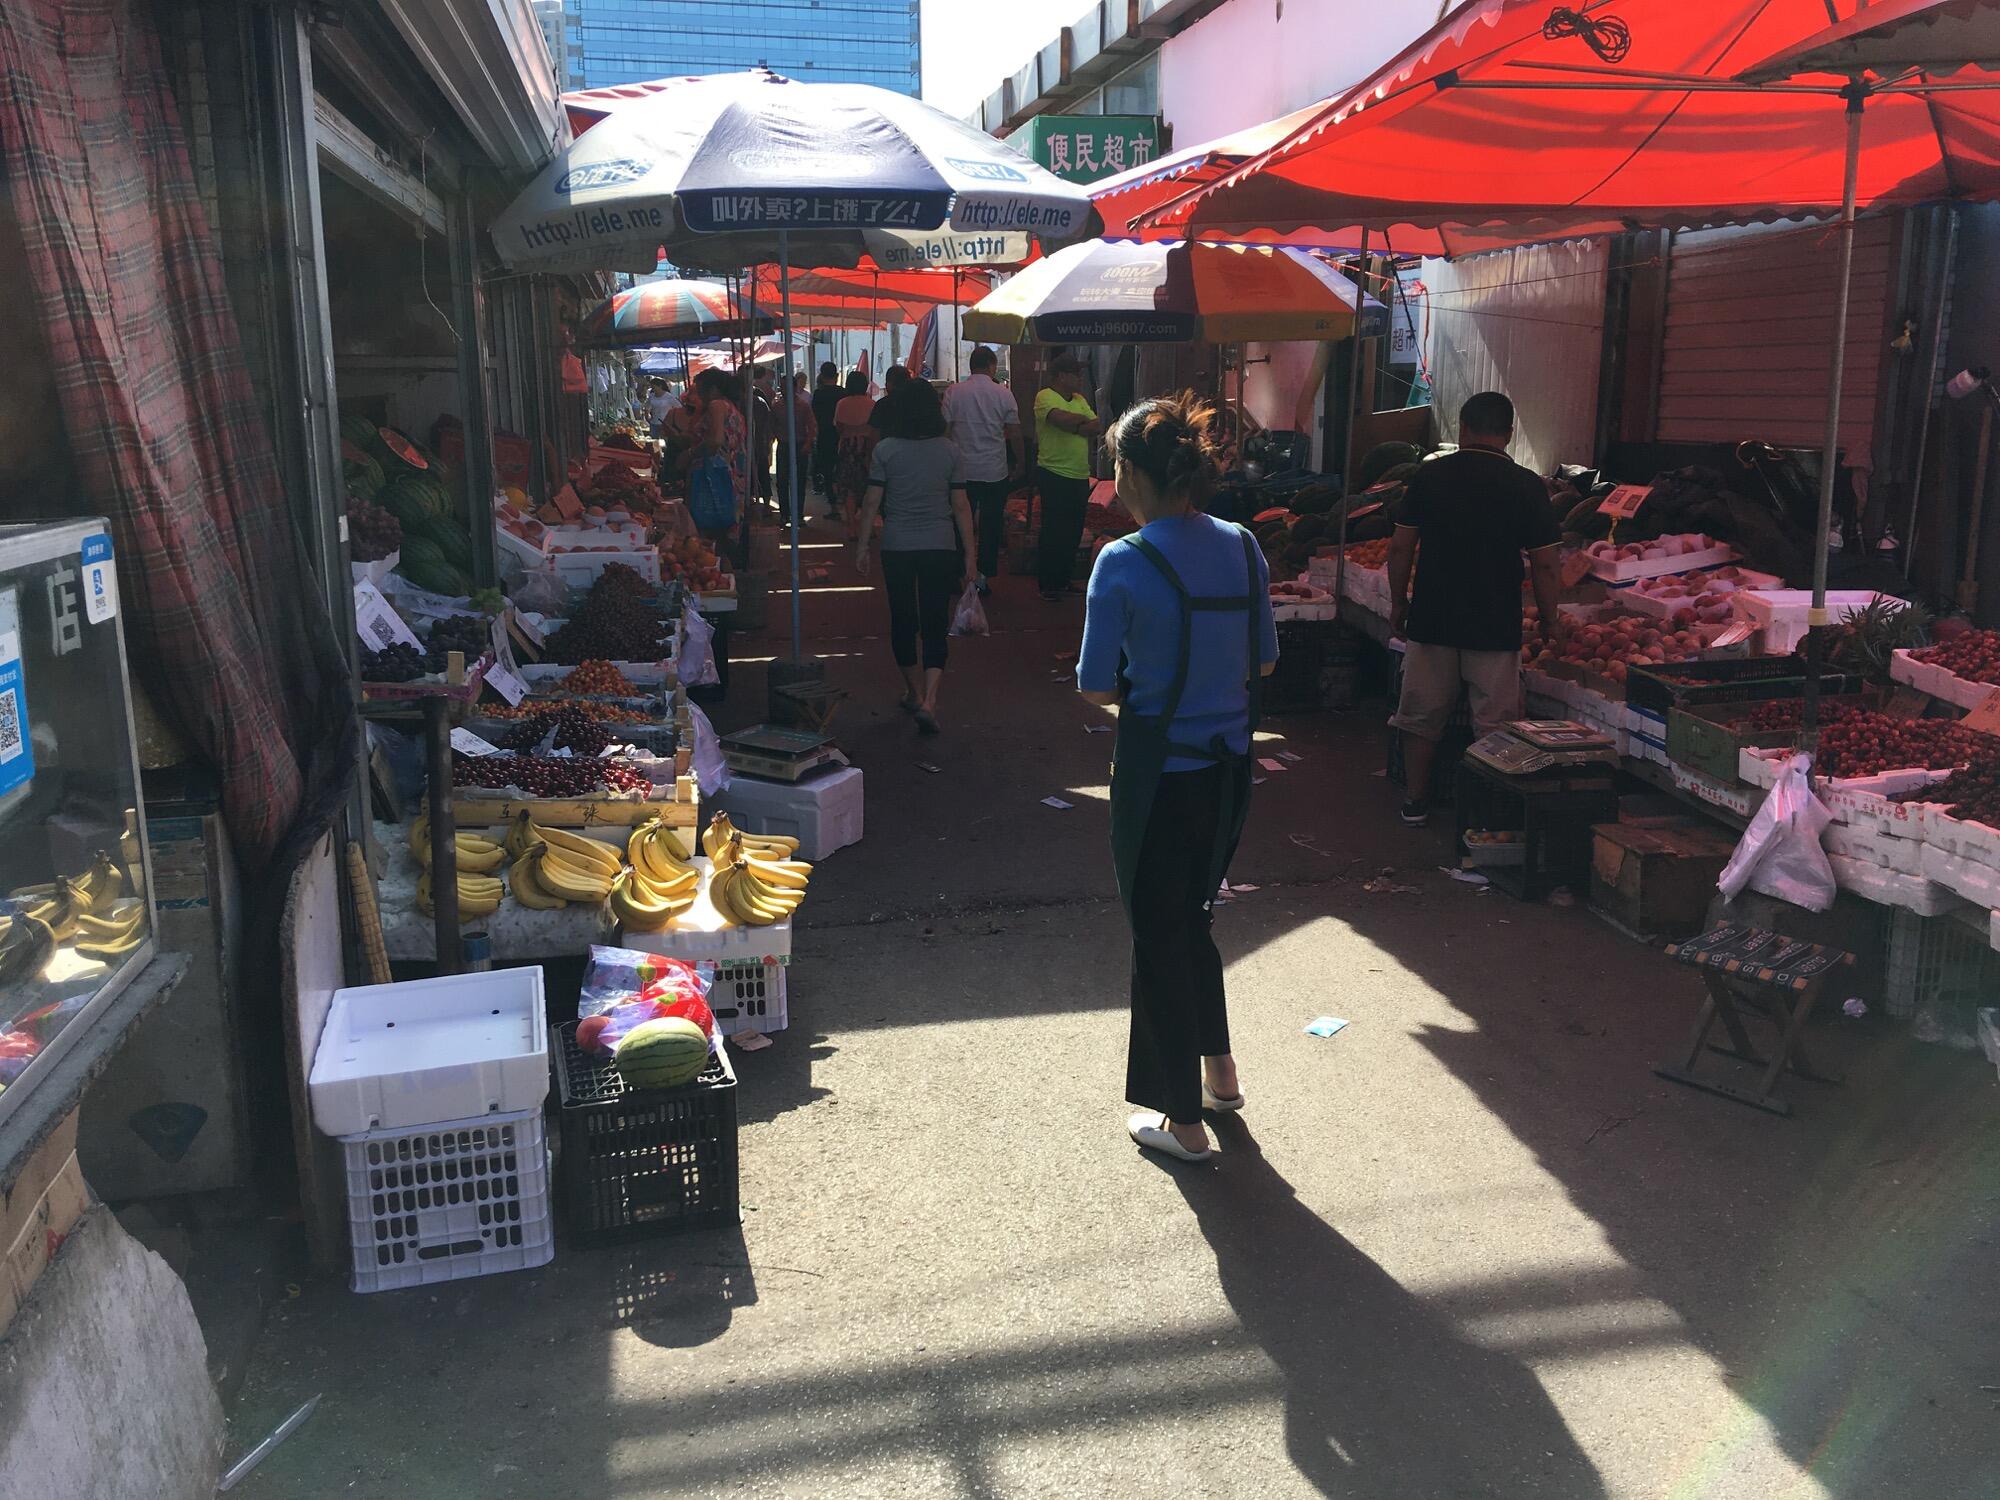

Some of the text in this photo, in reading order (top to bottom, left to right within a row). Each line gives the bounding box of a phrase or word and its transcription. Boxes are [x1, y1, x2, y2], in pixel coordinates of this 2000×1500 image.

[1046, 132, 1154, 172] 便民超市
[520, 207, 662, 249] http://ele.me
[960, 199, 1071, 229] http://ele.me
[1392, 328, 1416, 352] 超市
[46, 560, 82, 657] 店
